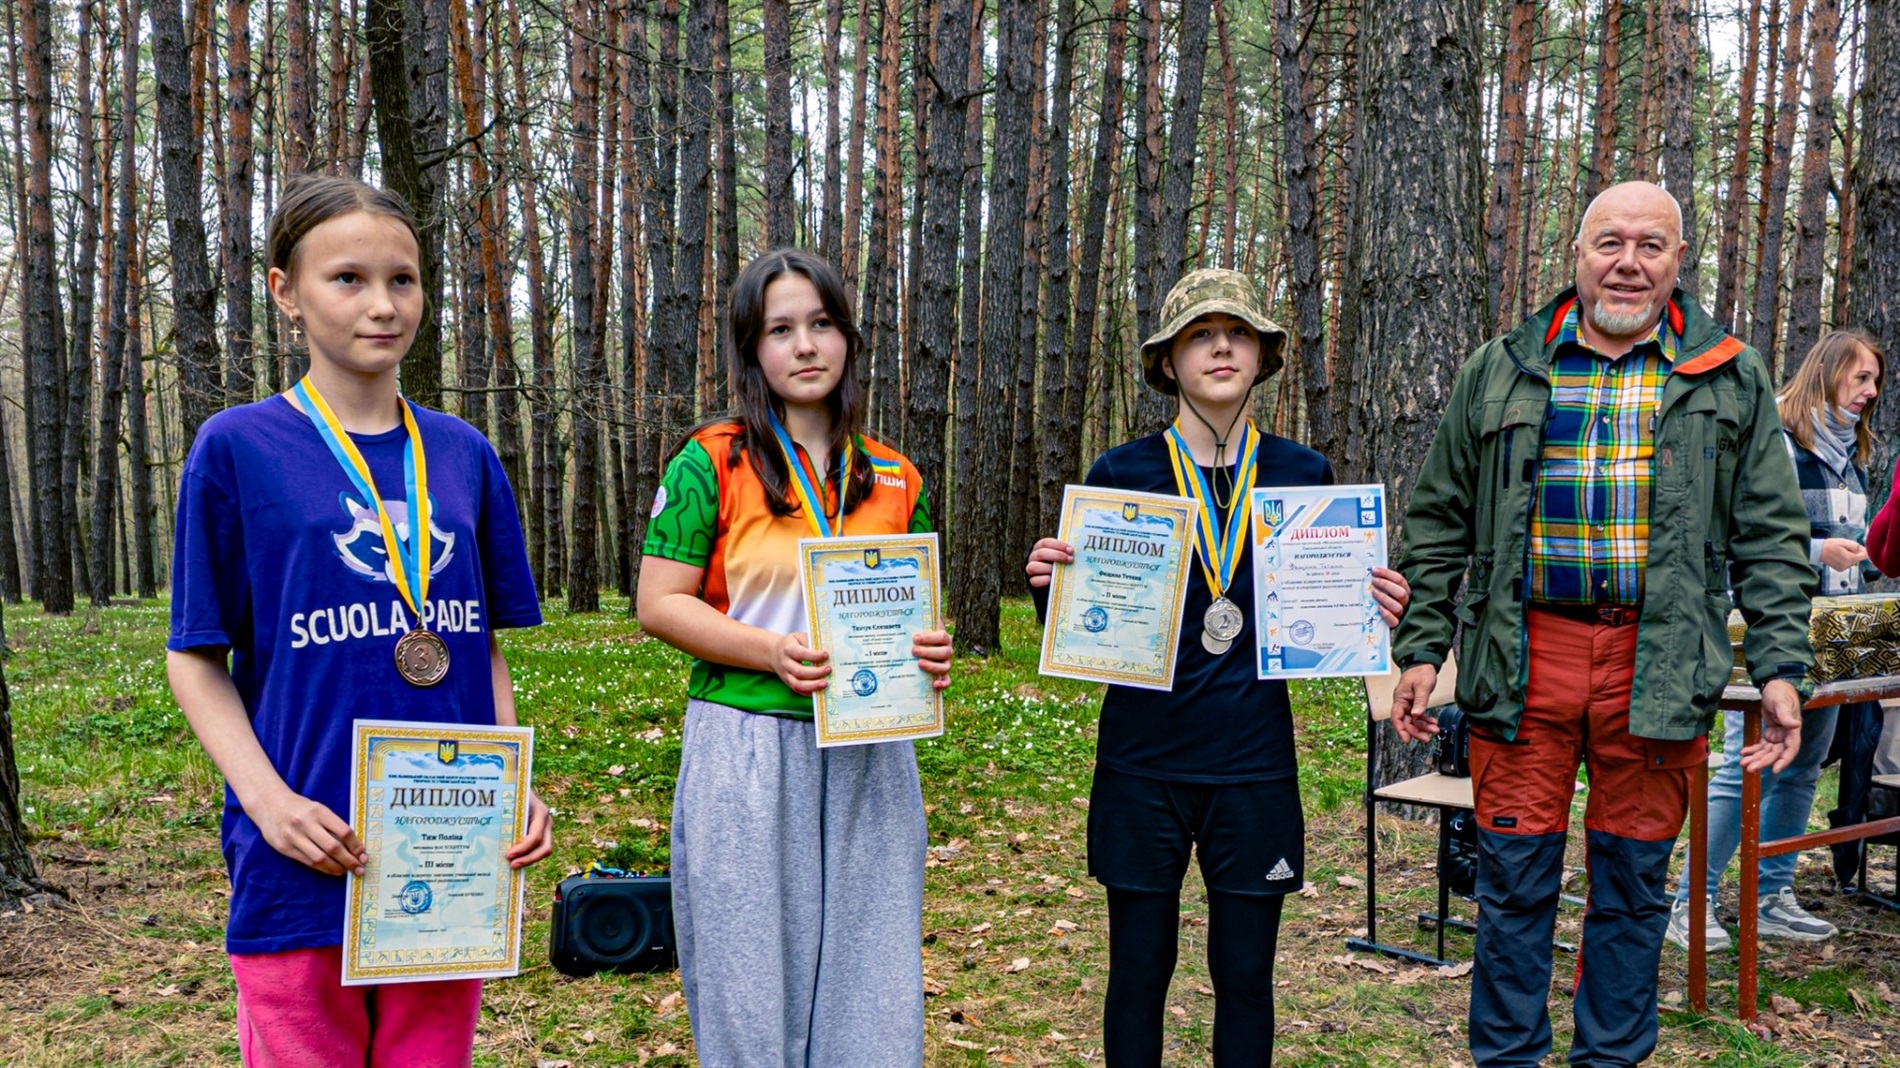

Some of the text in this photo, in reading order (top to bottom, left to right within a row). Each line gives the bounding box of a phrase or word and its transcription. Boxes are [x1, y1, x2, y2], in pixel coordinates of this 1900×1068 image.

[1290, 527, 1350, 541] ДИПЛОМ
[1083, 534, 1166, 558] ДИПЛОМ
[833, 586, 916, 608] ДИПЛОМ
[291, 600, 410, 649] SCUOLA
[1217, 612, 1229, 630] 2
[414, 644, 431, 672] 3
[389, 786, 496, 810] ДИПЛОМ
[438, 833, 463, 841] Поліна
